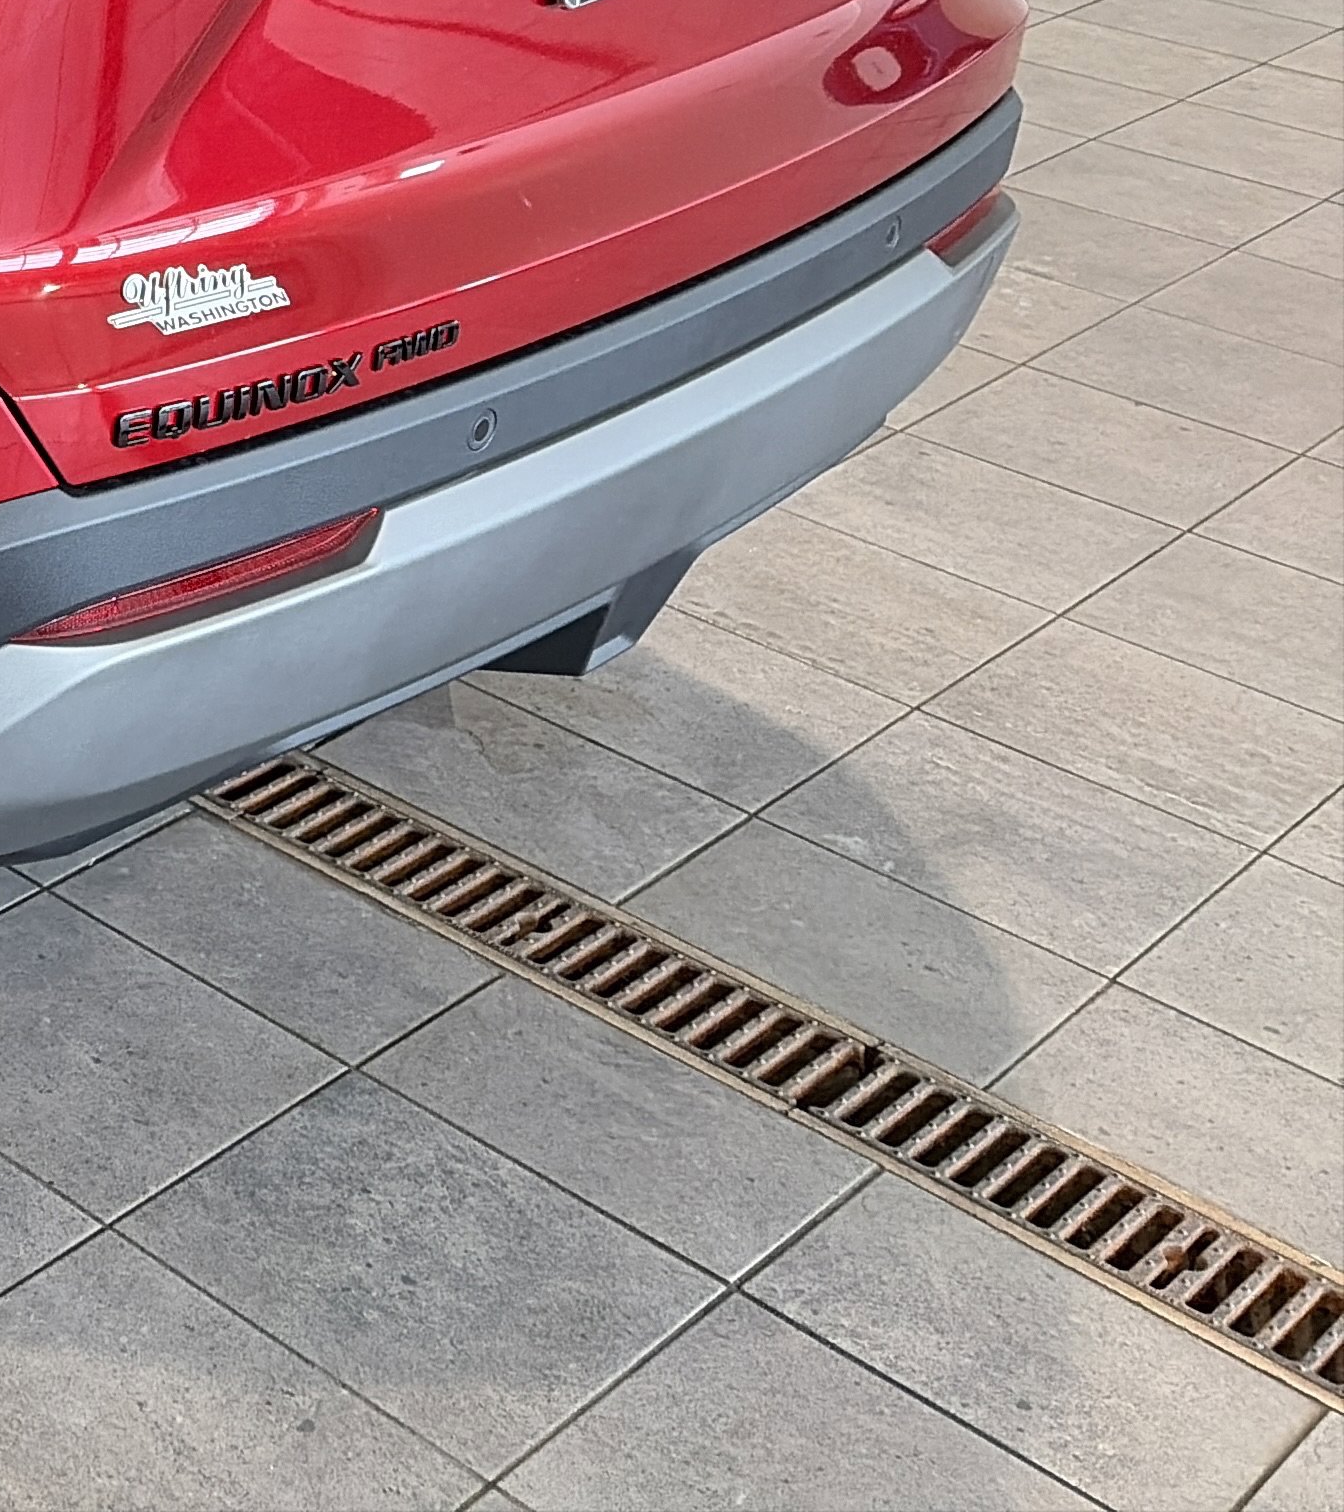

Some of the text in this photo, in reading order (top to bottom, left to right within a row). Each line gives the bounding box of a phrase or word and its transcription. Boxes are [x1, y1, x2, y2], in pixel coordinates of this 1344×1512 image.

[155, 289, 289, 334] WASHINGTON
[112, 319, 461, 450] EQUINOX AWD
